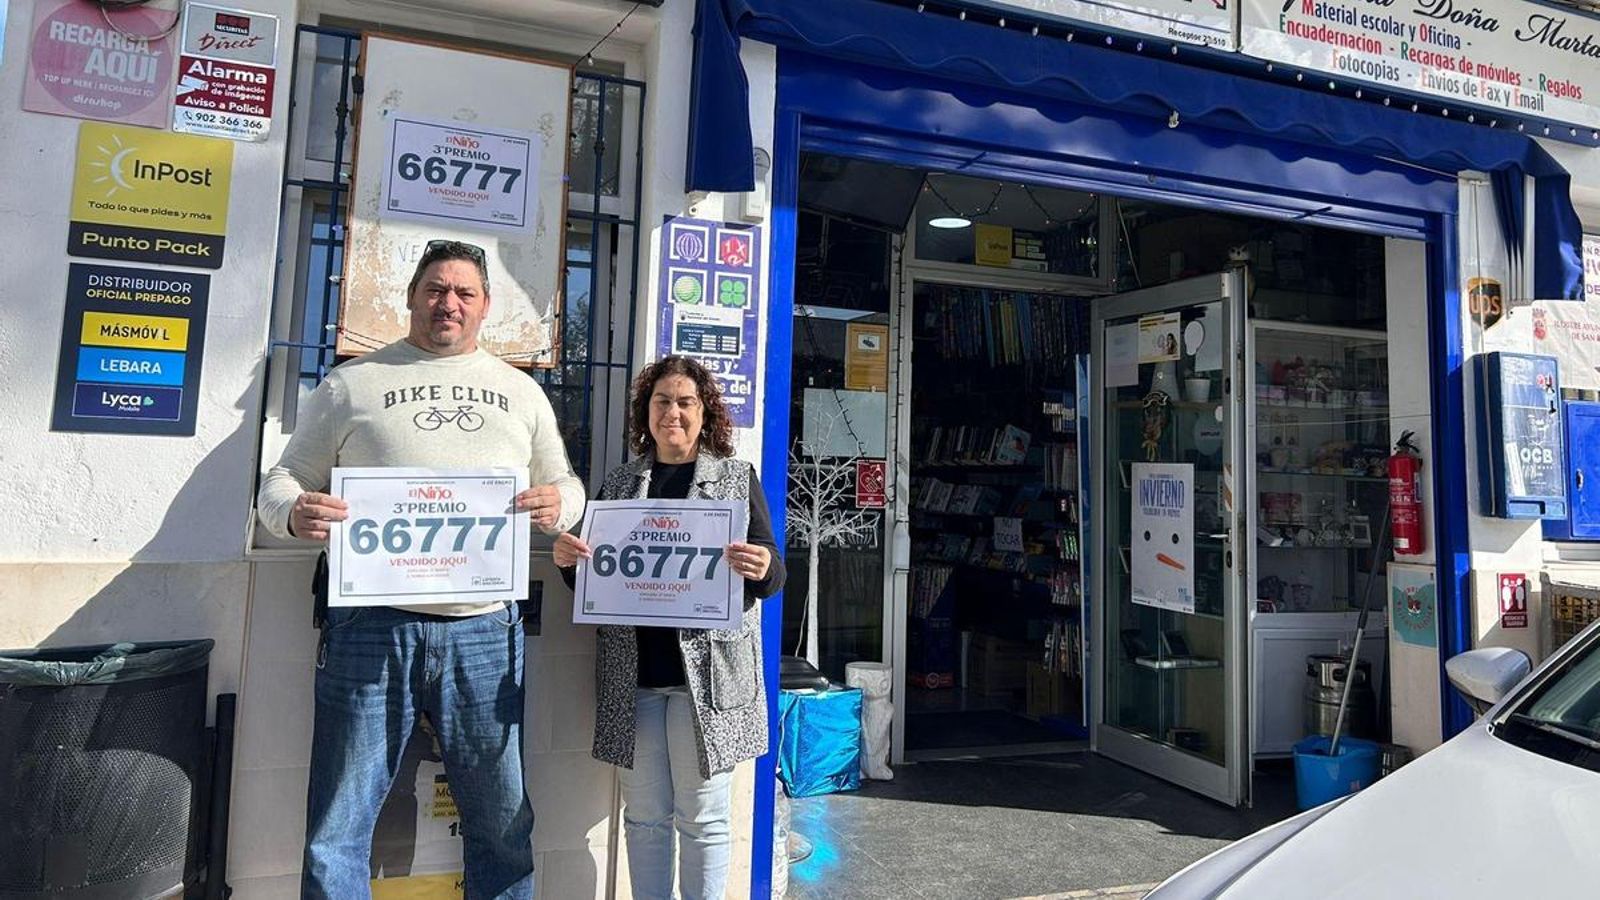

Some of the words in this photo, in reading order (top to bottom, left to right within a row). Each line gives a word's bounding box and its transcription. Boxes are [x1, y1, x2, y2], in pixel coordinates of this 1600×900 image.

[1168, 27, 1202, 41] Receptor
[1301, 0, 1357, 27] Material
[1361, 13, 1405, 37] escolar
[1408, 25, 1416, 42] y
[1419, 23, 1461, 50] Oficina
[49, 20, 149, 54] RECARGA
[198, 33, 264, 51] Direct
[1514, 14, 1600, 58] Marta
[84, 48, 163, 83] AQUÍ
[1279, 14, 1382, 55] Encuadernacion
[1400, 41, 1455, 73] Recargas
[1458, 56, 1473, 76] de
[1476, 63, 1521, 86] móviles
[1539, 73, 1582, 100] Regalos
[44, 74, 60, 82] TOP
[188, 60, 268, 85] Alarma
[1332, 50, 1400, 82] Fotocopias
[1463, 79, 1477, 97] de
[1480, 79, 1500, 101] Fax
[1503, 90, 1511, 106] y
[1514, 89, 1544, 112] Email
[211, 88, 223, 96] de
[224, 89, 265, 102] imágenes
[228, 84, 266, 94] grabación
[184, 96, 216, 108] Aviso
[218, 102, 226, 110] a
[228, 102, 265, 115] Policía
[195, 112, 216, 123] 902
[219, 116, 239, 126] 366
[243, 119, 263, 129] 366
[452, 136, 480, 149] Niño
[445, 146, 491, 161] PREMIO
[133, 159, 213, 187] InPost
[398, 153, 522, 194] 66777
[428, 186, 467, 199] VENDIDO
[88, 201, 115, 210] Todo
[118, 203, 127, 211] lo
[129, 206, 149, 214] que
[151, 208, 179, 217] pides
[189, 212, 212, 221] más
[82, 232, 150, 251] Punto
[155, 239, 211, 257] Pack
[88, 275, 192, 294] DISTRIBUIDOR
[86, 289, 132, 301] OFICIAL
[135, 292, 191, 305] PREPAGO
[100, 323, 170, 341] MÁSMÓVL
[100, 359, 161, 374] LEBARA
[730, 381, 751, 395] del
[102, 392, 141, 410] Lyca
[384, 385, 441, 409] BIKE
[452, 386, 509, 413] CLUB
[1520, 448, 1553, 463] OCB
[418, 485, 452, 499] Niño
[1139, 479, 1185, 509] INVIERNO
[408, 501, 466, 514] PREMIO
[650, 516, 680, 530] Niño
[349, 516, 507, 555] 66777
[642, 531, 691, 543] PREMIO
[390, 557, 437, 567] VENDIDO
[593, 544, 724, 580] 66777
[625, 582, 666, 591] VENDIDO
